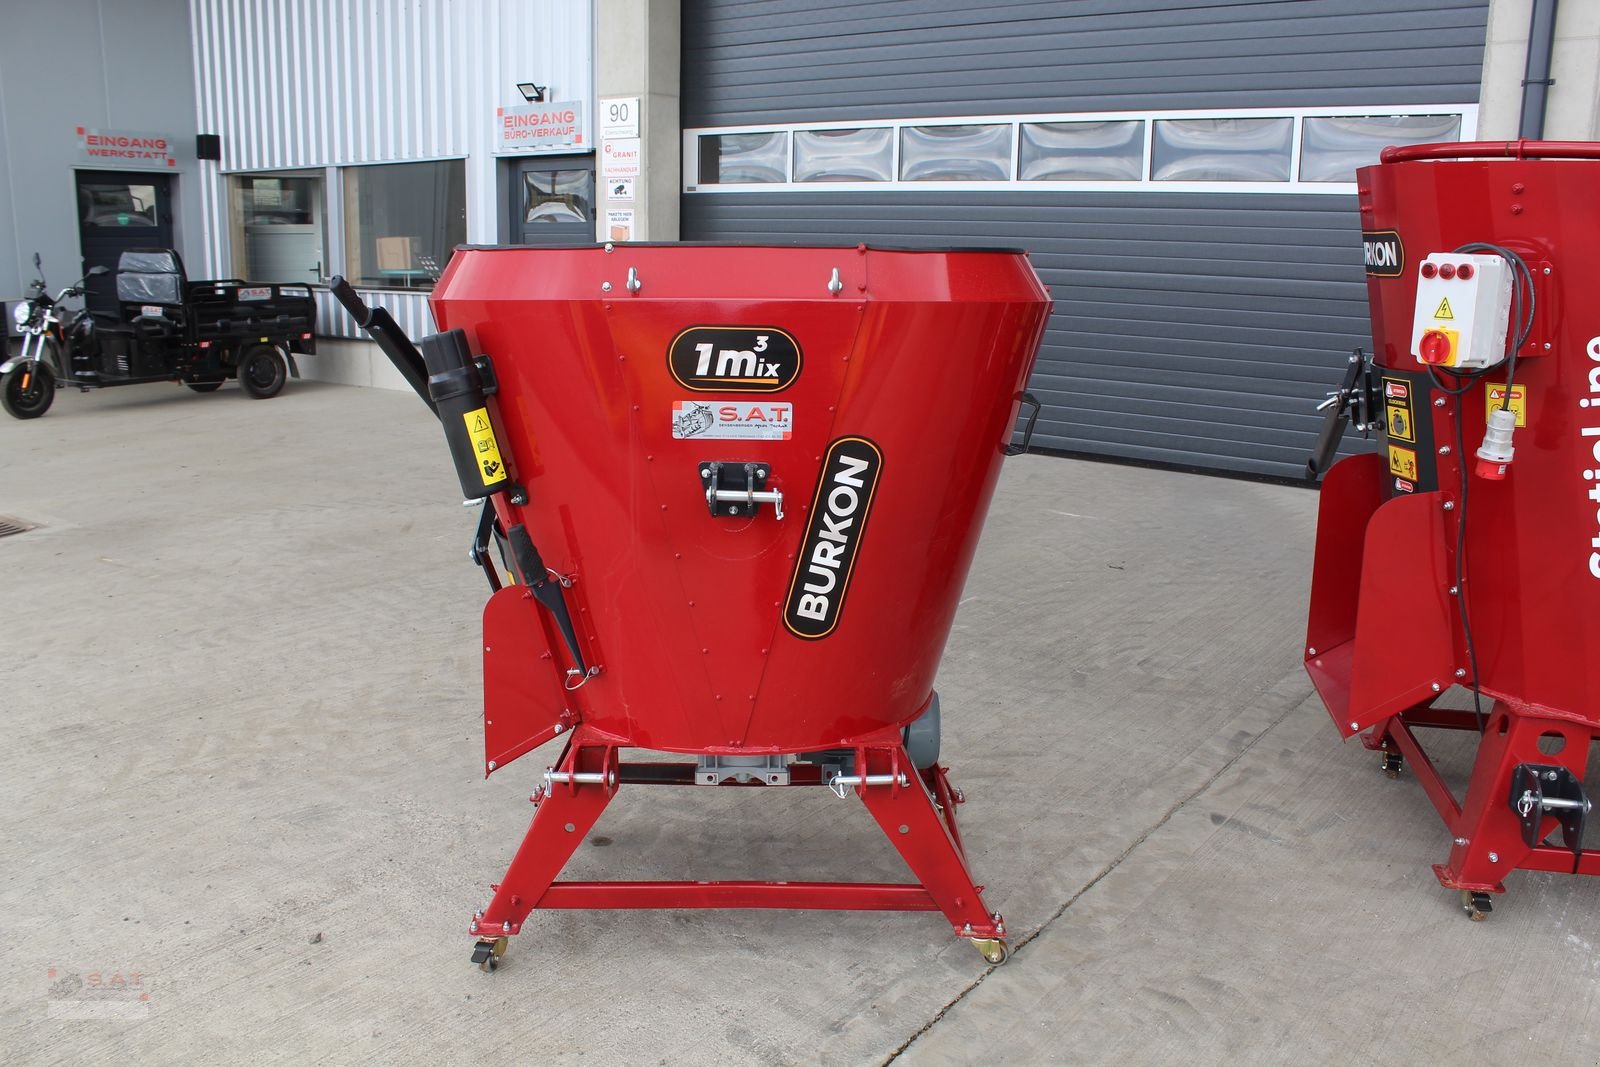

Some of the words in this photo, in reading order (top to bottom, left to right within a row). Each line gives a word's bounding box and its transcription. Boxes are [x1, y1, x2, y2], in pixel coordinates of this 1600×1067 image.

[504, 111, 575, 128] EINGANG
[610, 104, 628, 122] 90
[504, 126, 575, 140] BÜRO-VERKAUF
[87, 135, 167, 149] EINGANG
[88, 149, 167, 160] WERKSTATT
[719, 406, 788, 421] S.A.T.
[797, 455, 869, 621] BURKON
